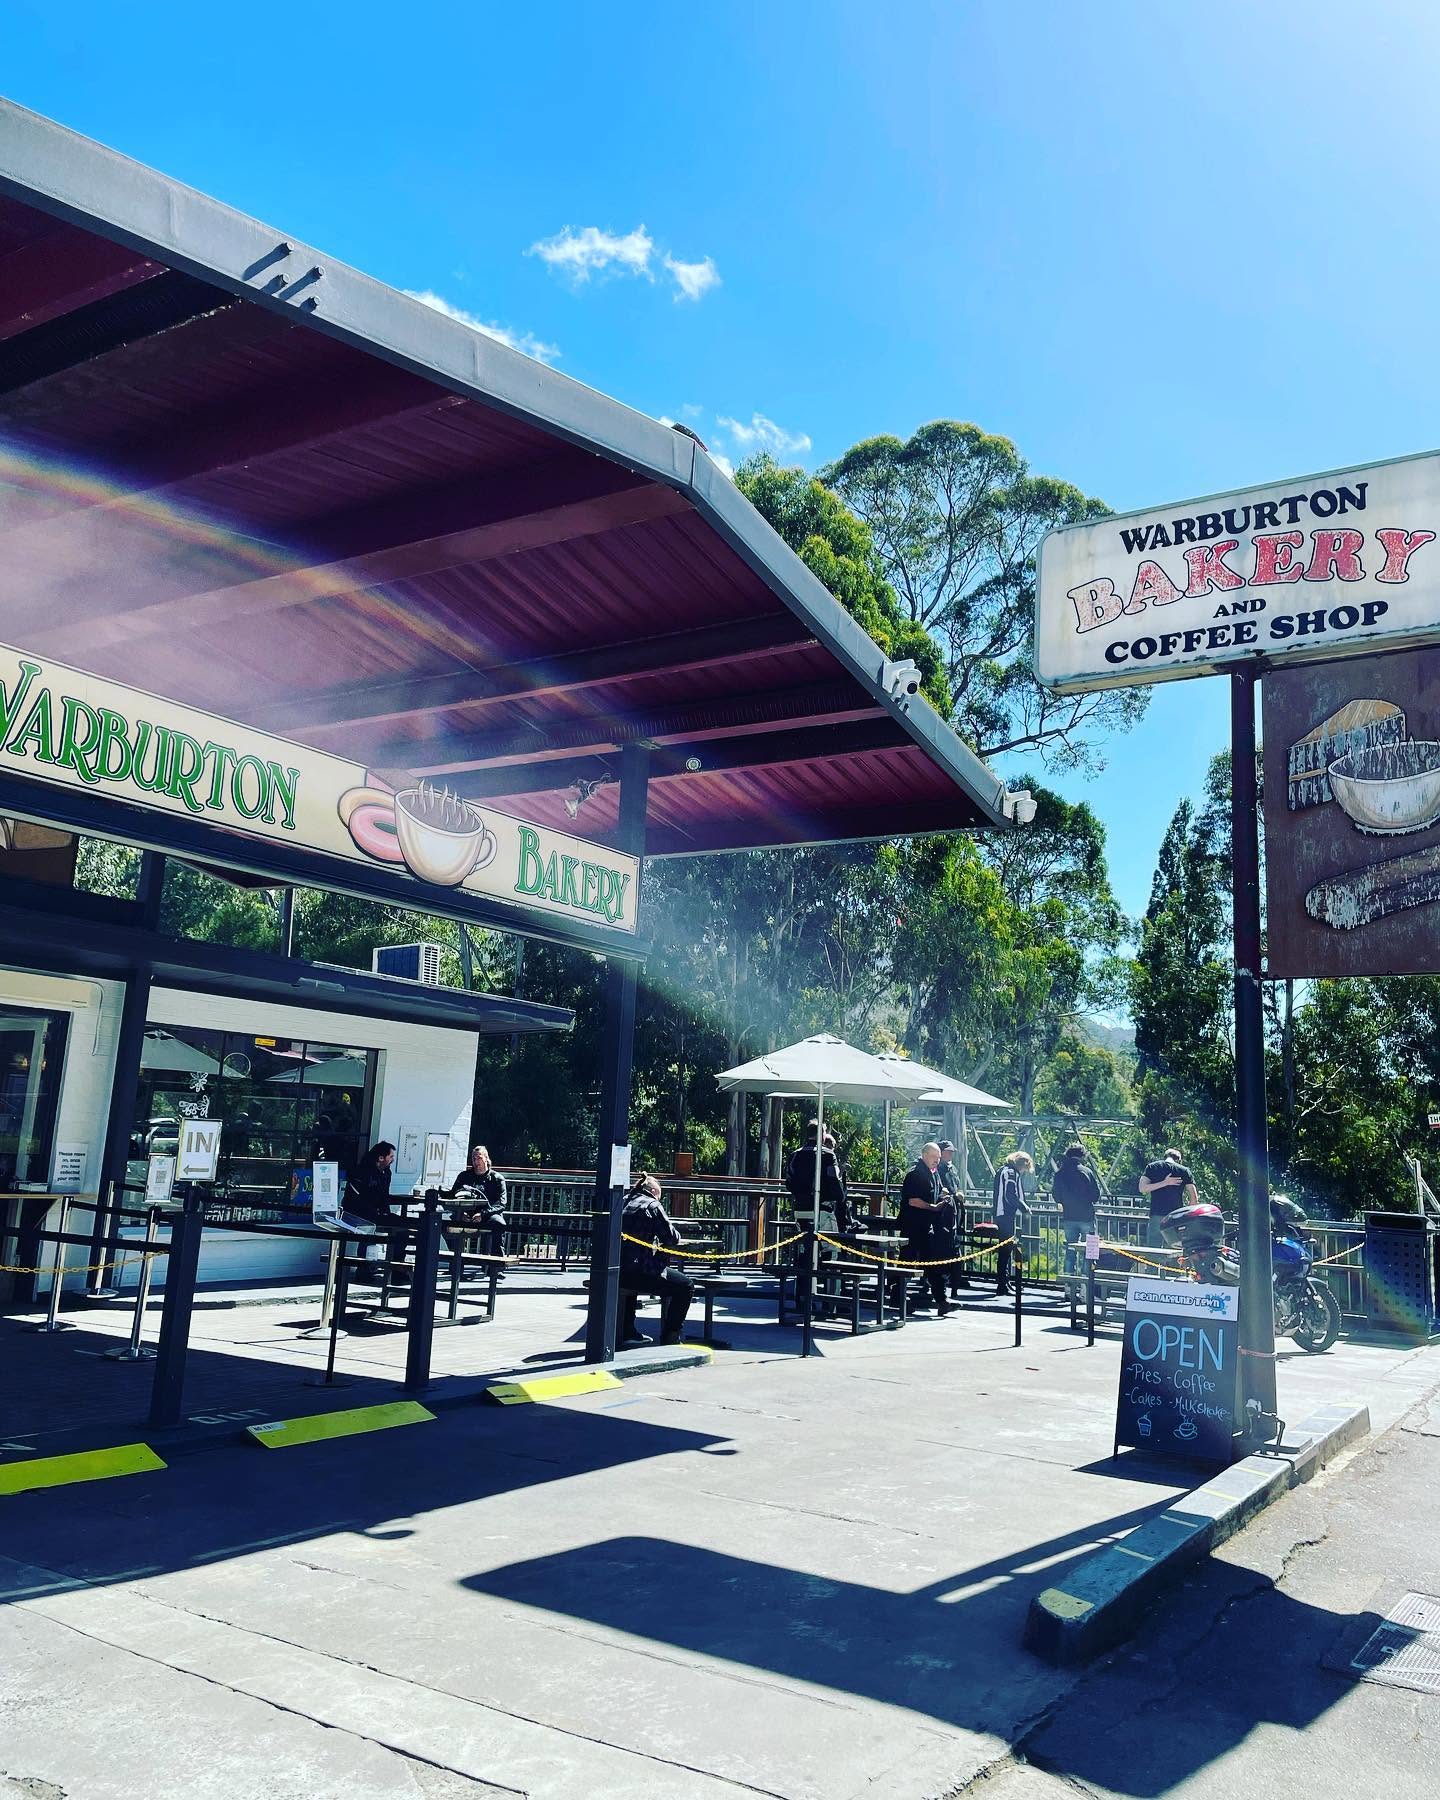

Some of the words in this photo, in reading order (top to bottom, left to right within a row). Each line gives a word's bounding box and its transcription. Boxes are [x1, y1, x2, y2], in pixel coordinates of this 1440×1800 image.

[1119, 482, 1368, 554] WARBURTON
[1067, 528, 1436, 634] BAKERY
[1213, 598, 1266, 618] AND
[1105, 620, 1258, 663] COFFEE
[1270, 600, 1389, 640] SHOP
[516, 825, 631, 923] BAKERY
[186, 1132, 213, 1153] IN
[429, 1143, 444, 1161] IN
[1133, 1318, 1224, 1371] OPEN
